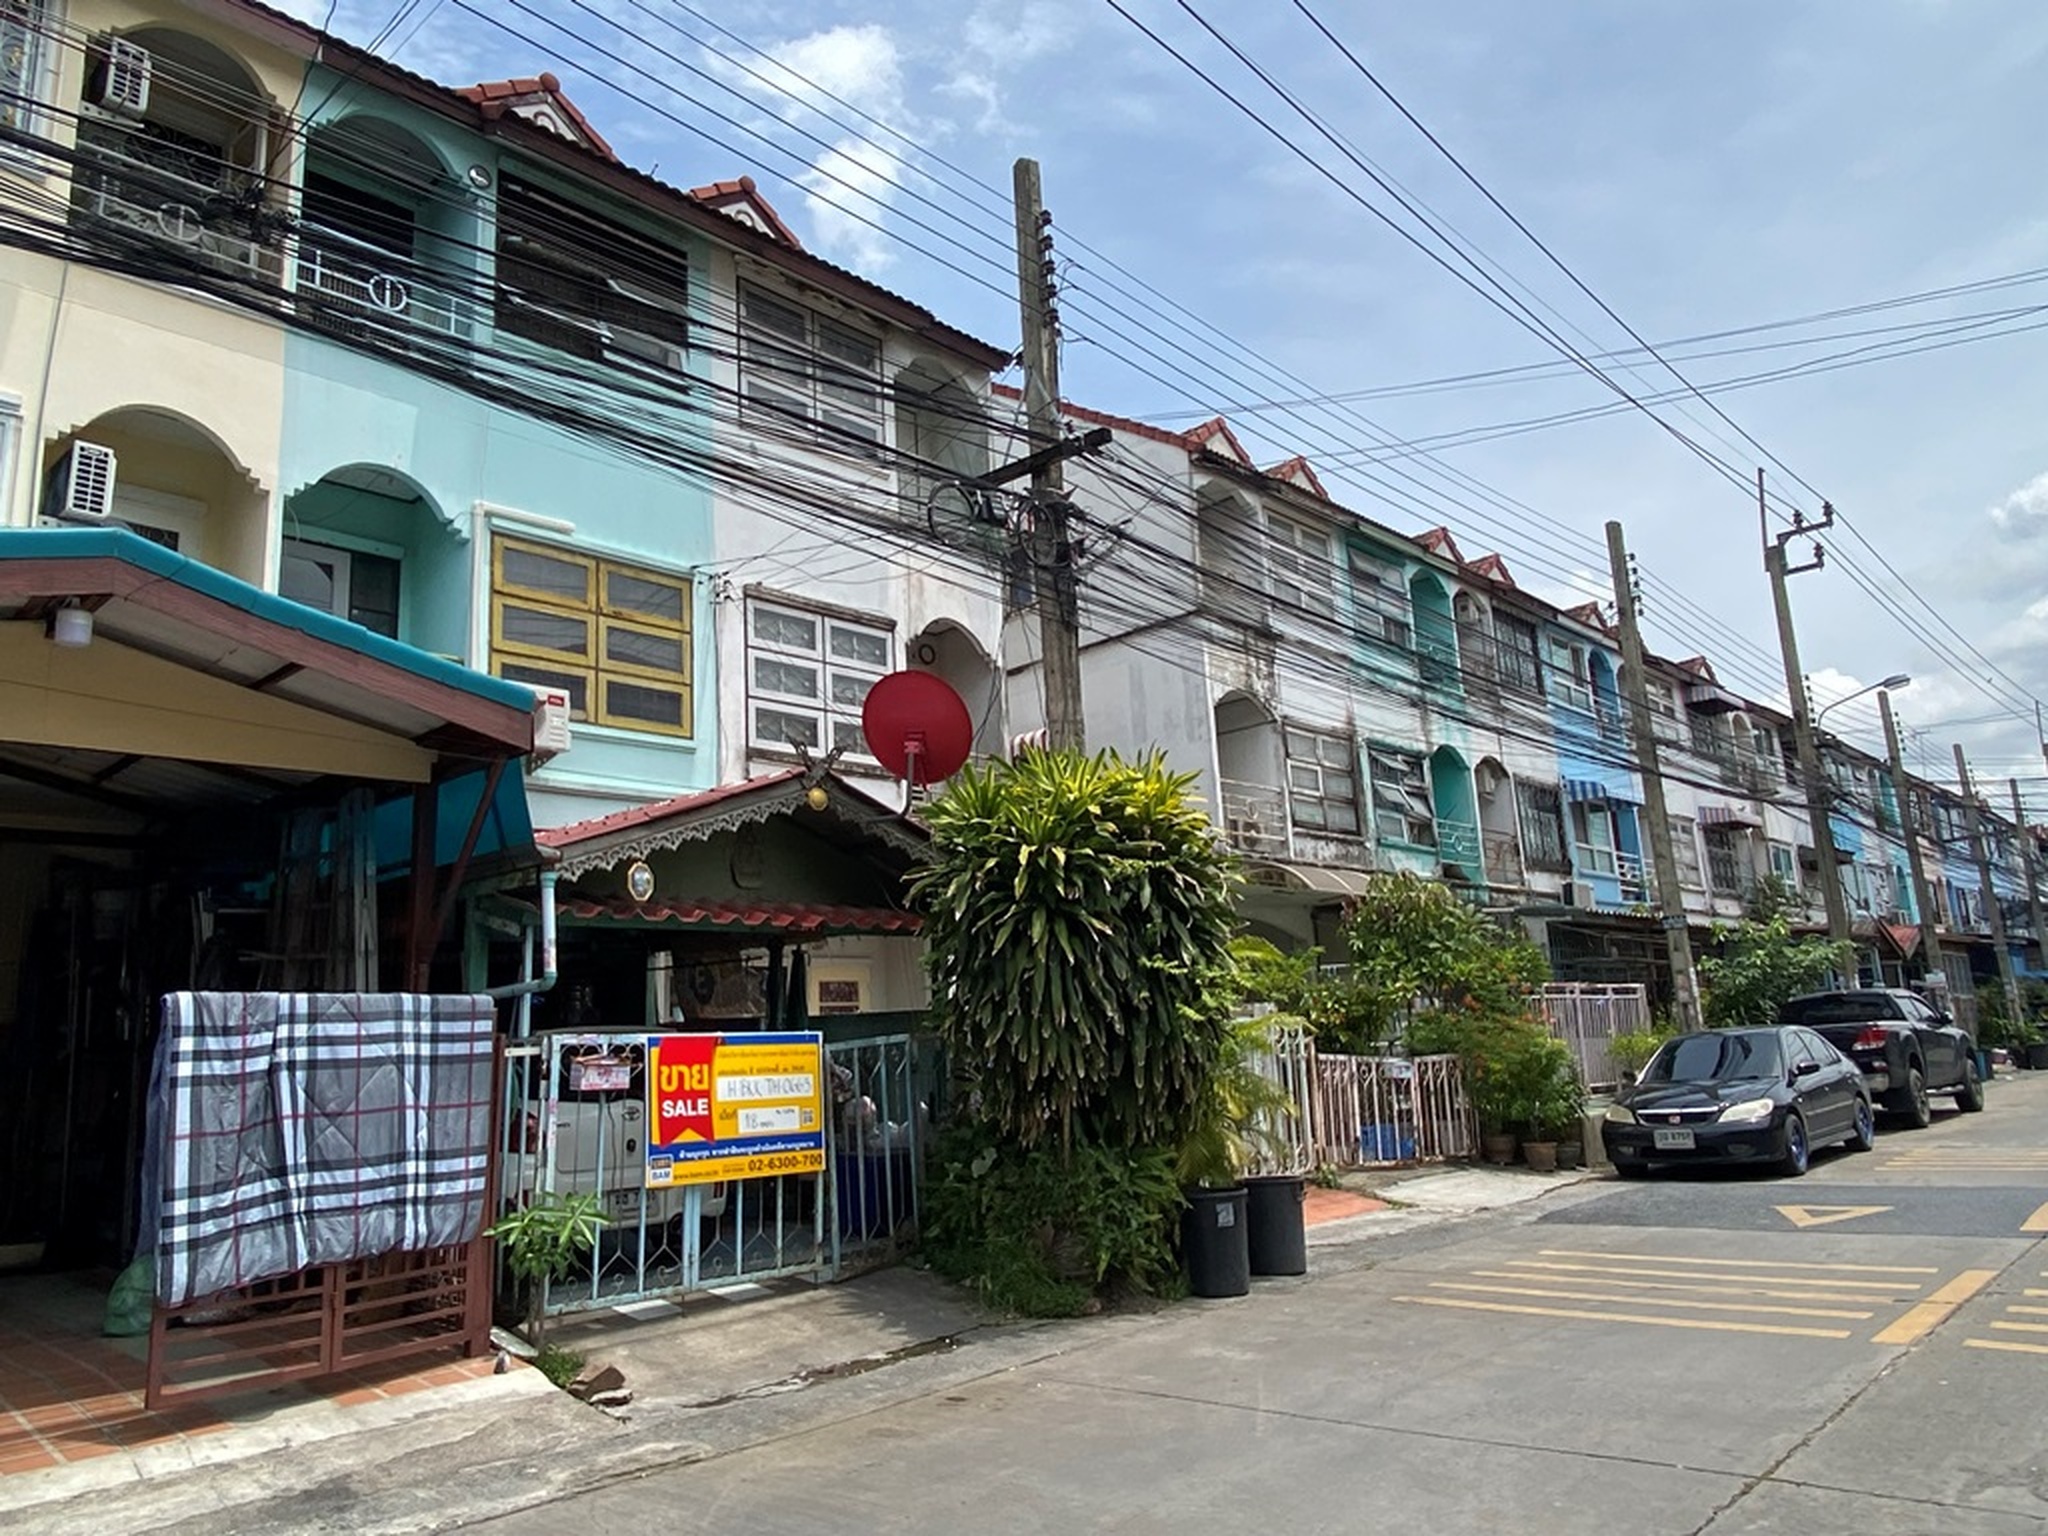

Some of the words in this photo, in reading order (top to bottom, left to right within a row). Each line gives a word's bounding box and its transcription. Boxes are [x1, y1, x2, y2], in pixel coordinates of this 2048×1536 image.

[660, 1064, 709, 1092] ขาย
[662, 1098, 709, 1117] SALE
[748, 1154, 823, 1172] 02-6300-700
